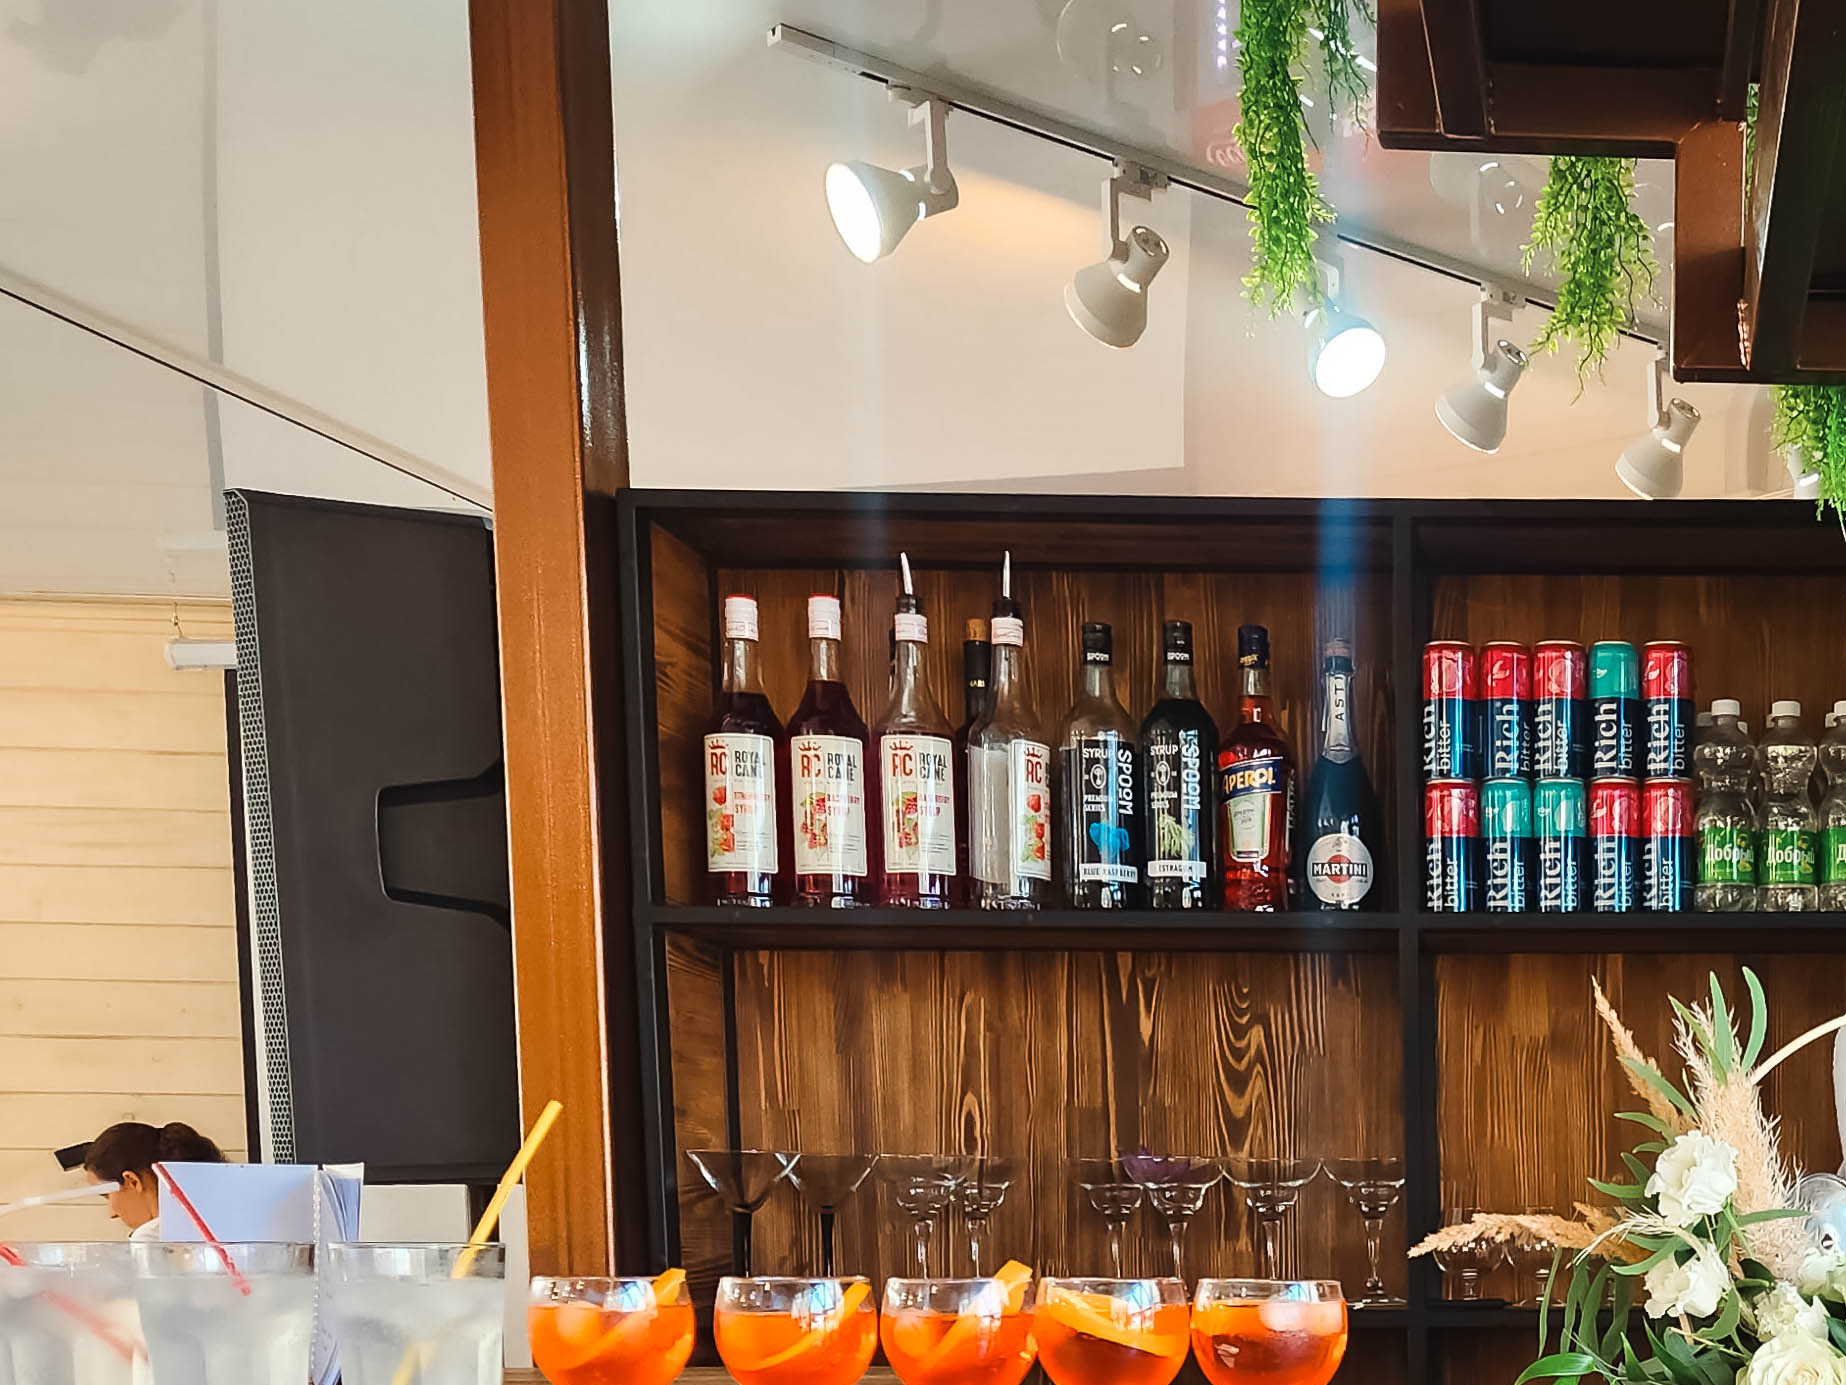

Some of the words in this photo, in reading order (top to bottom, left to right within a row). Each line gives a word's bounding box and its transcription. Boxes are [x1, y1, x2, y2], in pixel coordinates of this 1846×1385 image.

[1334, 675, 1345, 722] ASTI
[1150, 745, 1179, 756] SYRUP
[1495, 703, 1520, 769] Rich
[1520, 722, 1531, 771] bitter
[1593, 703, 1617, 769] Rich
[1647, 703, 1670, 770] Rich
[1672, 723, 1685, 770] bitter
[710, 752, 728, 776] RC
[801, 753, 821, 778] RC
[1026, 759, 1043, 784] RC
[1118, 748, 1134, 815] SPOOM
[1224, 766, 1276, 794] APEROL
[1313, 863, 1367, 876] MARTINI
[1444, 857, 1458, 907] bitter
[1659, 857, 1674, 907] bitter
